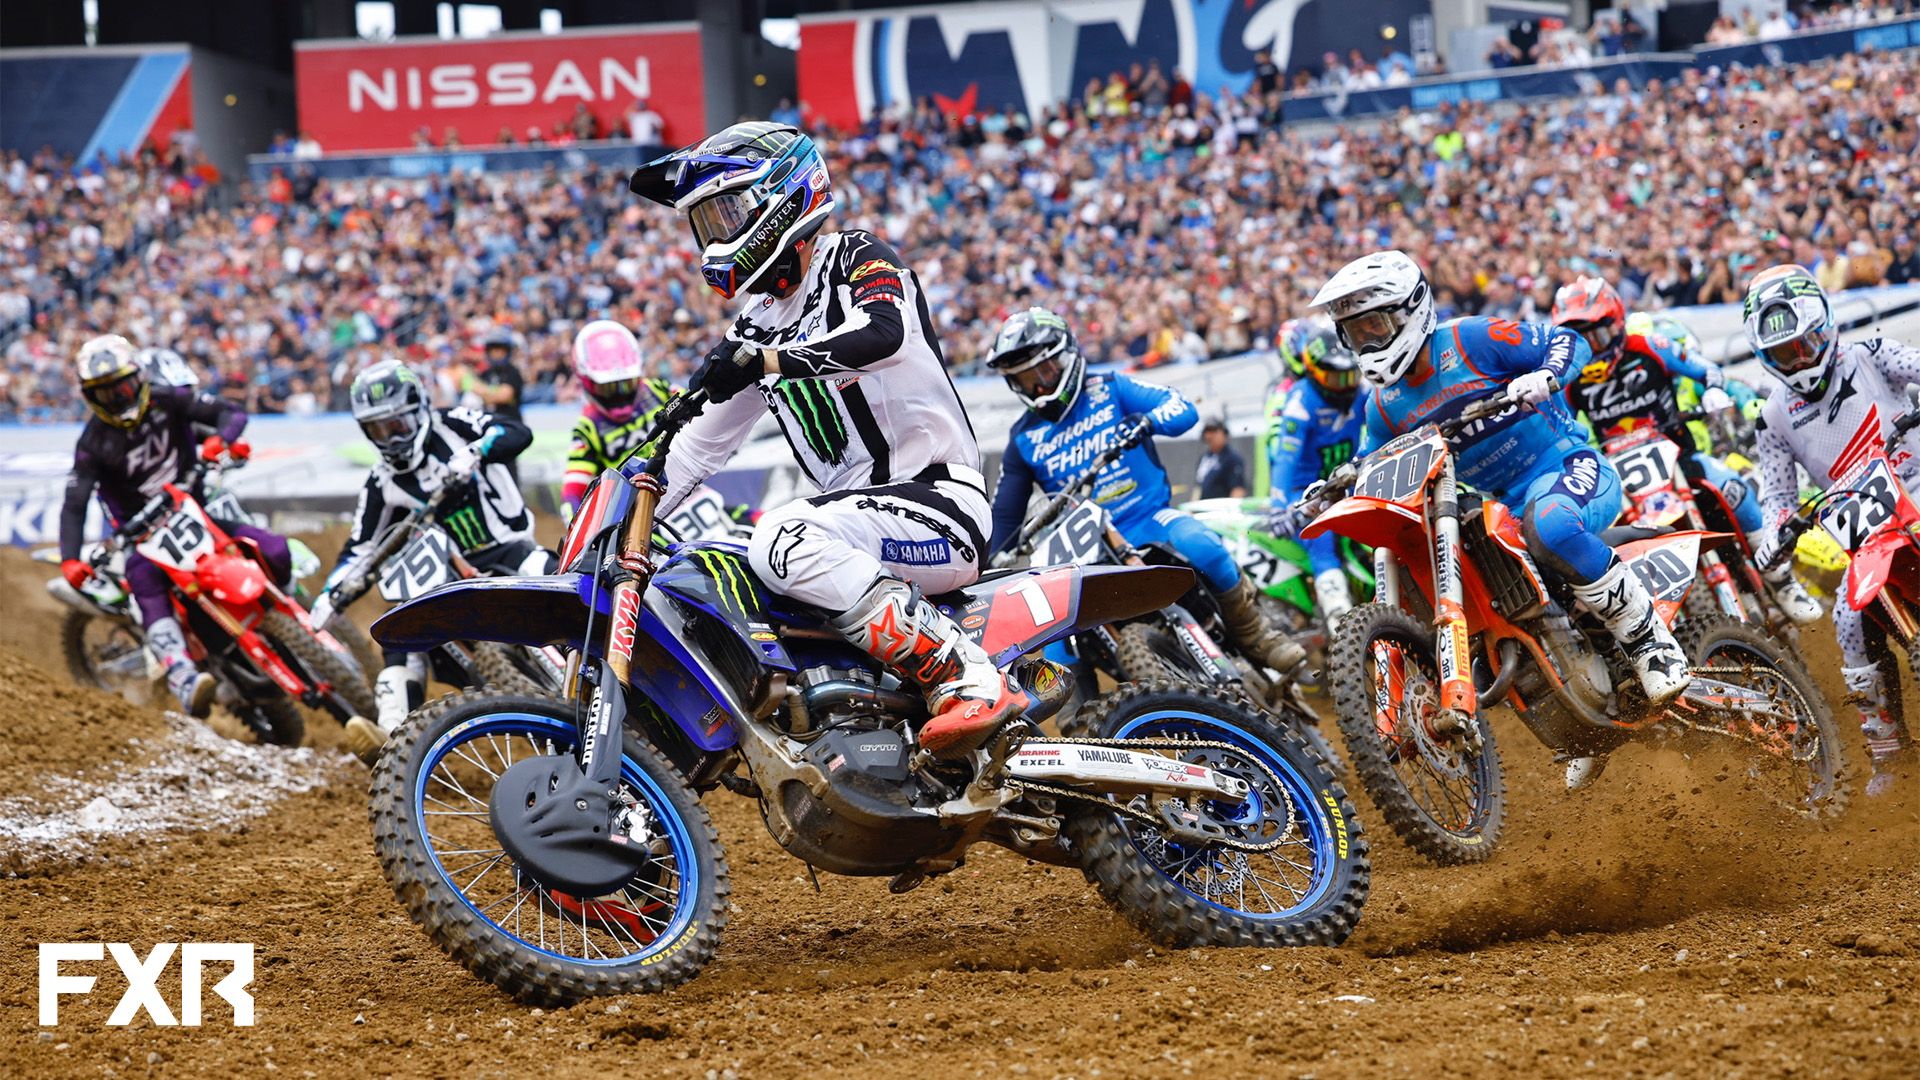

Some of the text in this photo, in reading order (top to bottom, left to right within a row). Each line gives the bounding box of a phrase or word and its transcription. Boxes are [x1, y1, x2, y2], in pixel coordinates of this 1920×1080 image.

[348, 56, 650, 112] NISSAN
[811, 172, 825, 190] BELL
[749, 200, 797, 249] MONSTER
[763, 213, 795, 248] ENERGY
[127, 428, 170, 476] FLY
[1032, 404, 1115, 462] FASTHOUSE
[1366, 443, 1432, 500] 80
[1615, 446, 1669, 493] 51
[158, 513, 205, 564] 15
[1048, 507, 1101, 566] 46
[1837, 476, 1897, 553] 23
[901, 543, 946, 562] YAMAHA
[1630, 549, 1691, 598] 80
[1005, 578, 1056, 627] 1
[1443, 658, 1451, 679] EBC
[582, 686, 603, 765] DUNLOP
[1077, 750, 1134, 765] YAMALUBE
[1324, 796, 1348, 860] DUNLOP
[641, 926, 698, 966] DUNLOP
